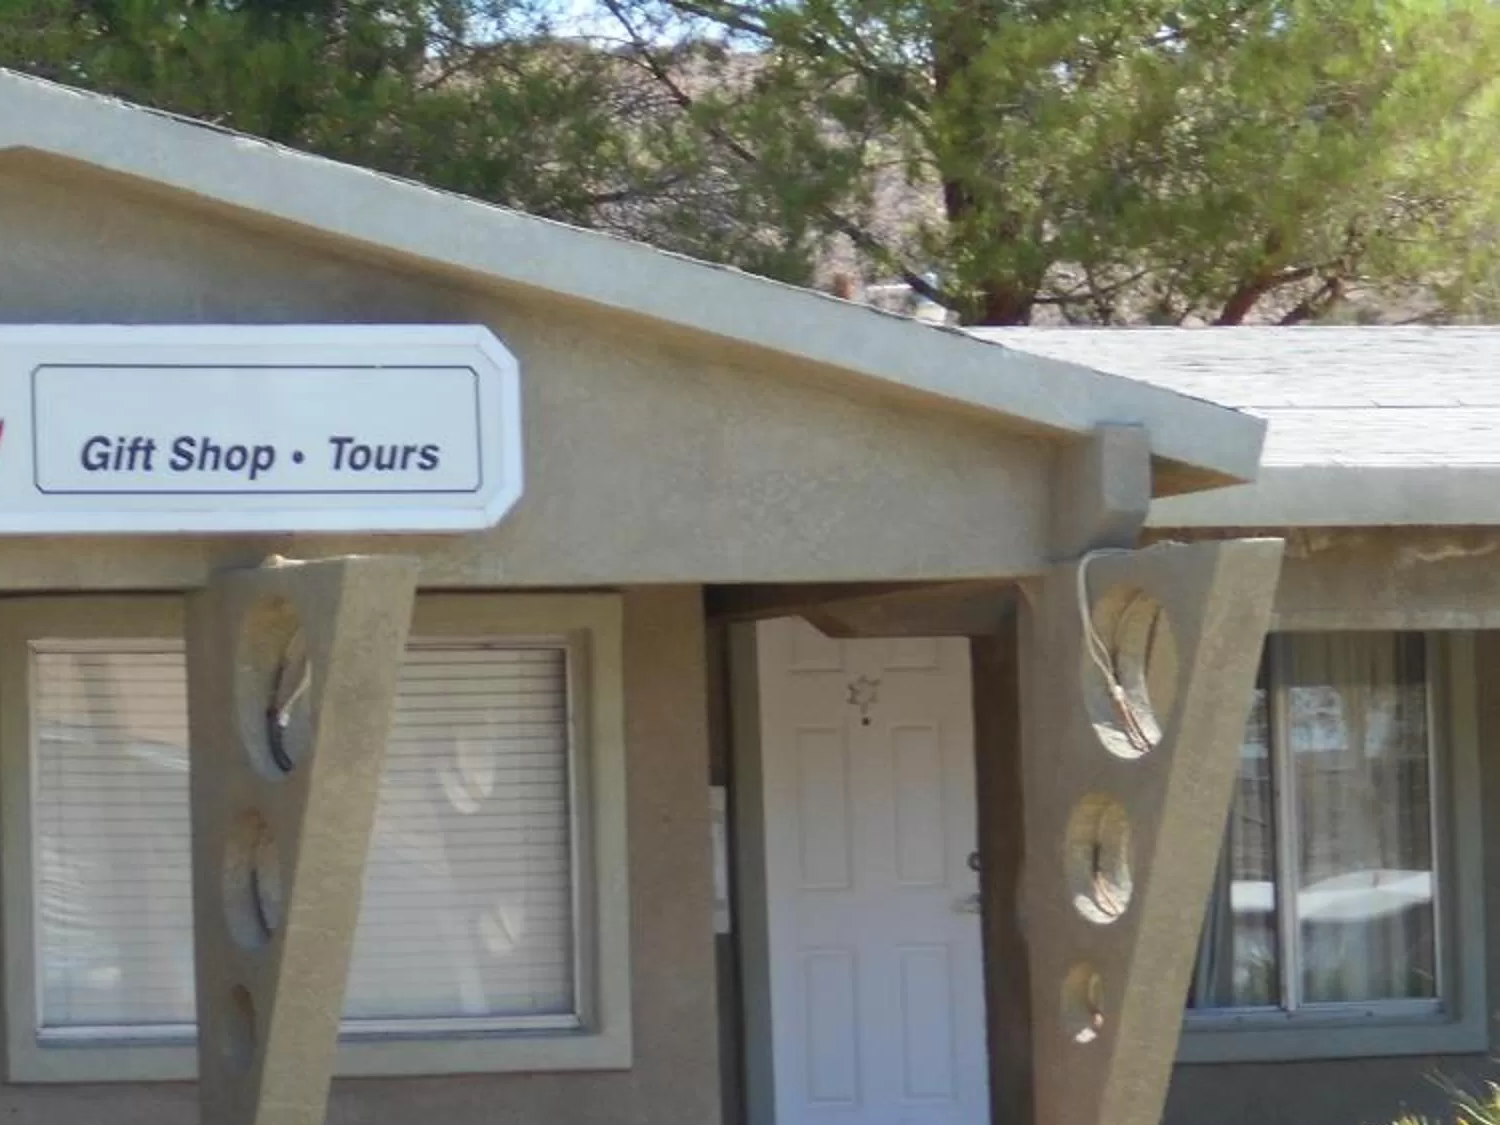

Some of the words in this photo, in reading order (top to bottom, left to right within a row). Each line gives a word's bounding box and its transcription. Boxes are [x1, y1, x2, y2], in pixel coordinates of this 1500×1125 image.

[80, 435, 156, 471] Gift
[169, 436, 275, 480] Shop
[329, 437, 440, 471] Tours
